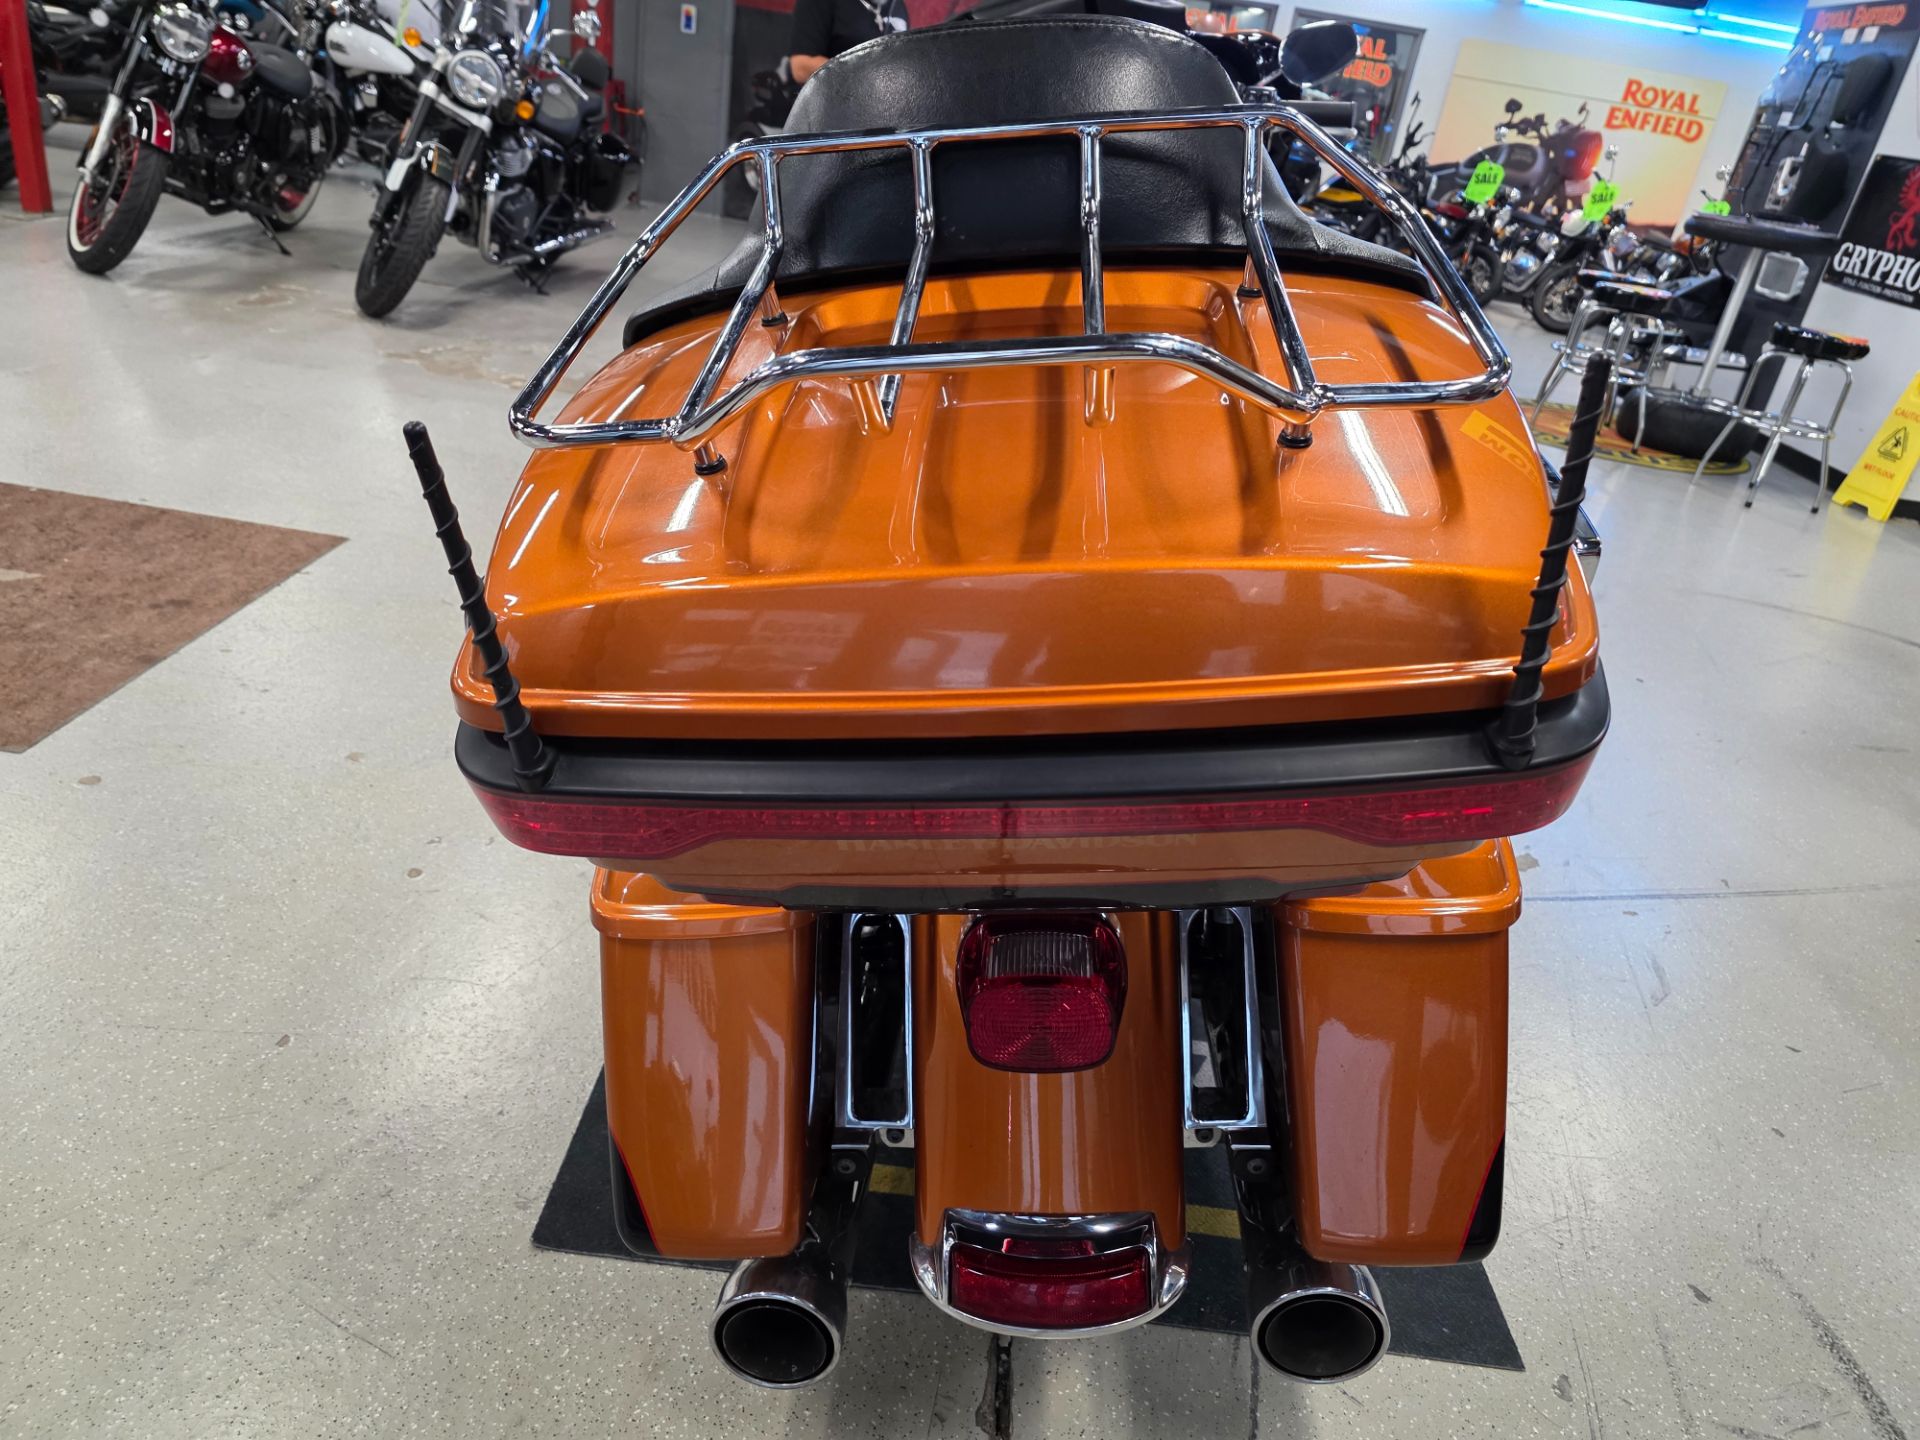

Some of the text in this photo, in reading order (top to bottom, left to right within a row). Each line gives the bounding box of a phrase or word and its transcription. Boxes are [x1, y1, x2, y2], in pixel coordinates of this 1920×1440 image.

[1621, 78, 1700, 115] ROYAL
[1604, 105, 1704, 142] ENFIELD
[1474, 172, 1498, 184] SALE
[1833, 242, 1920, 292] GRYPHO
